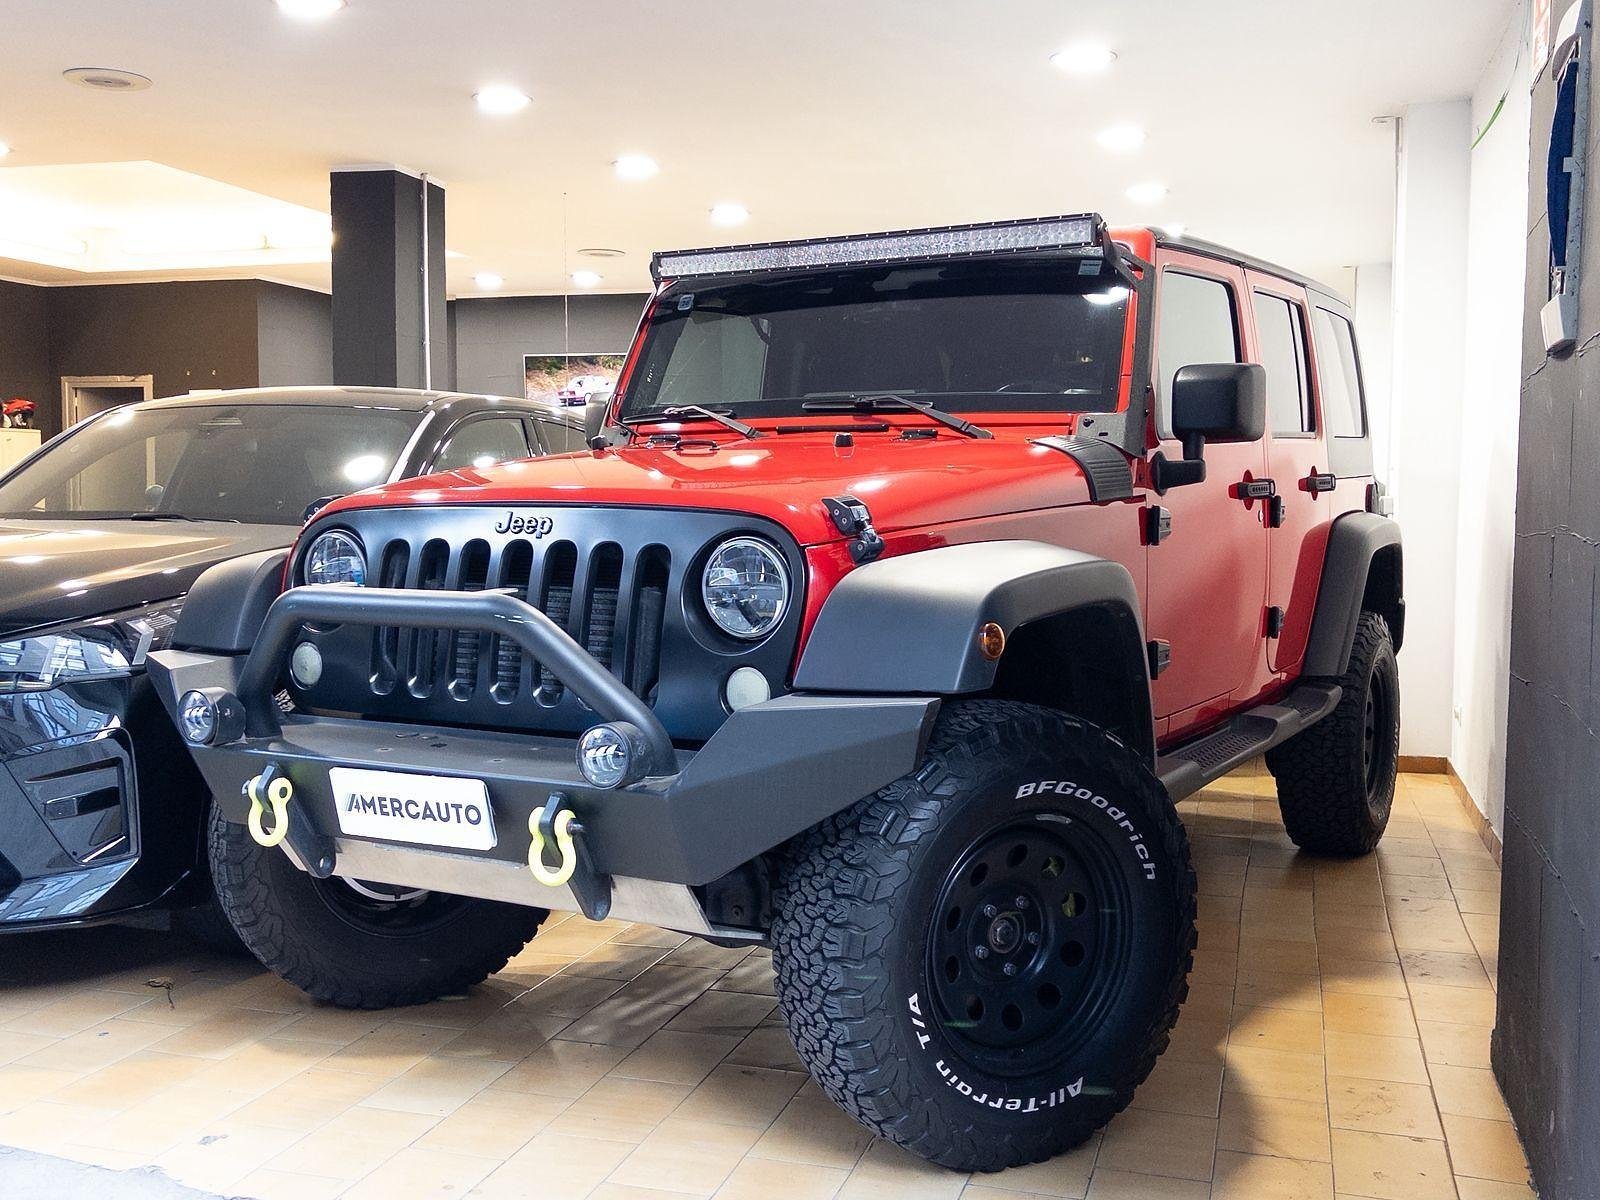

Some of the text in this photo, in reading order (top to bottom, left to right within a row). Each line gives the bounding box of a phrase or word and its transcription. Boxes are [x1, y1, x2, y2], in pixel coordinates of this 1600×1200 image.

[495, 510, 554, 540] Jeep
[346, 793, 482, 826] AMERCAUTO
[1015, 780, 1157, 881] BFGoodrich
[908, 992, 1084, 1113] All-Terrain T/A
